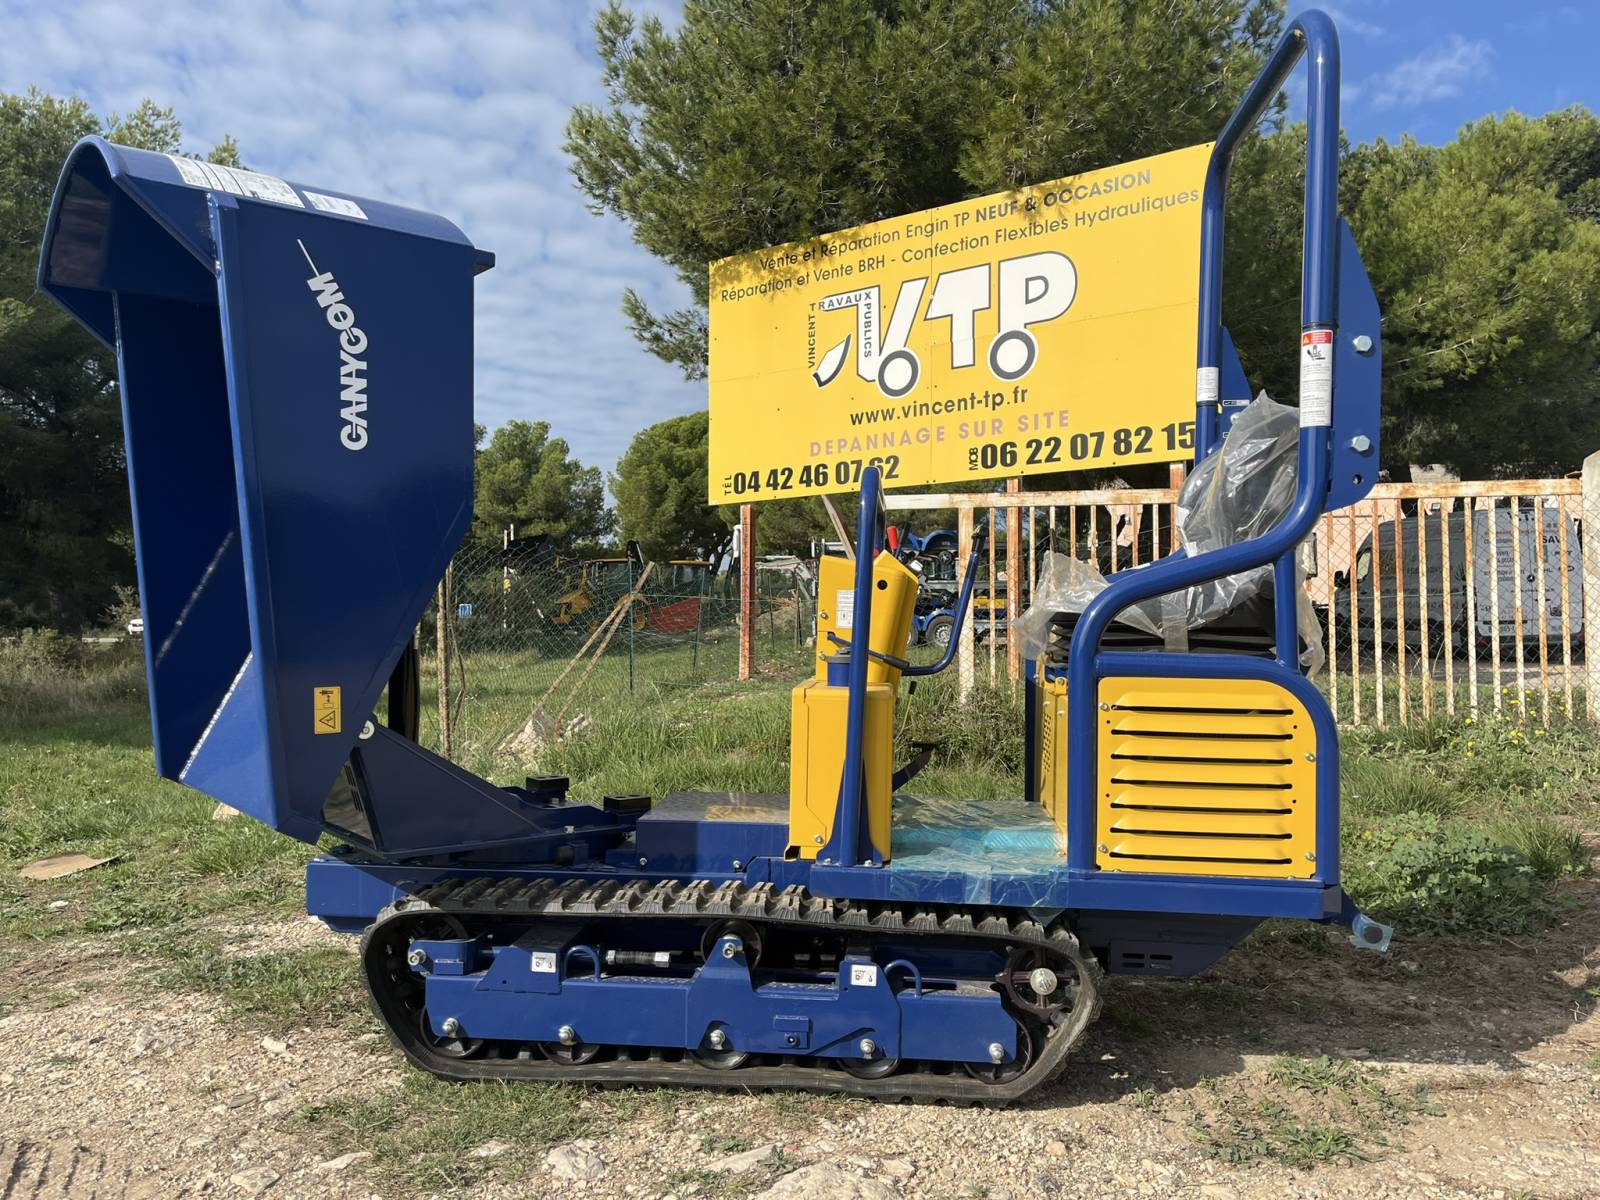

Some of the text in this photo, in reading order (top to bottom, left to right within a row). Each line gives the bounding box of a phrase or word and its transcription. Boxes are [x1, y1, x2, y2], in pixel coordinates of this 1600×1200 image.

[721, 275, 793, 302] Réparation
[797, 271, 811, 285] et
[814, 264, 853, 282] Vente
[859, 255, 885, 273] BRH
[902, 234, 989, 263] Confection
[995, 217, 1069, 244] Flexibles
[1075, 188, 1199, 227] Hydrauliques
[760, 169, 1151, 271] Vente et Réparation Engin TP NEUF & OCCASION
[808, 290, 872, 369] VINCENT TRAVAUX PUBLICS
[820, 250, 1078, 392] VTP
[307, 271, 369, 451] CANYCOM
[810, 410, 1070, 457] DEPANNAGE SUR SITE
[850, 386, 1028, 426] www.vincent-tp.fr
[733, 472, 761, 495] 04
[766, 467, 794, 490] 42
[799, 463, 829, 488] 46
[835, 459, 863, 485] 07
[969, 421, 1196, 471] MOB 06 22 07 82 15
